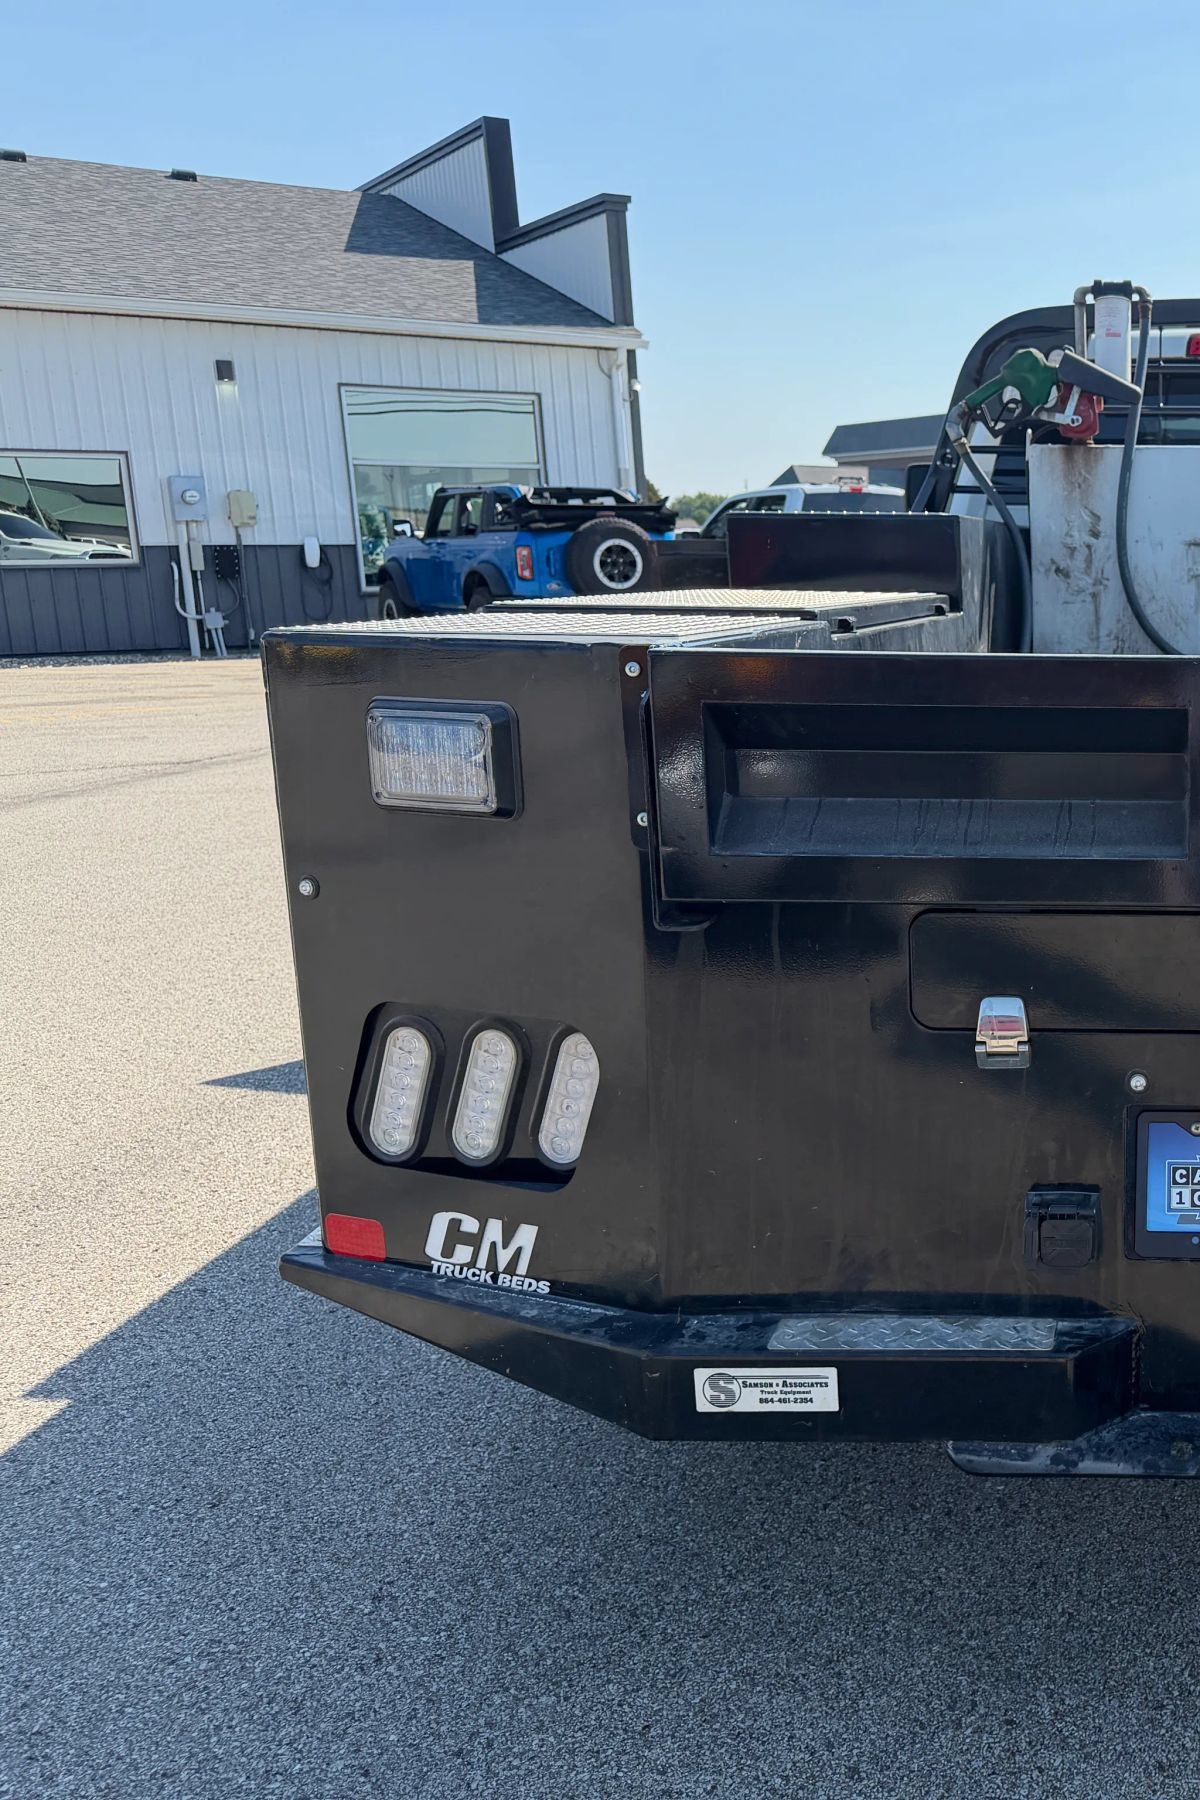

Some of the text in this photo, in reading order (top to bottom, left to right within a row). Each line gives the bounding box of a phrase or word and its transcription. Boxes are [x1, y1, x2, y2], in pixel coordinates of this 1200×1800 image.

[1174, 1190, 1187, 1206] 1
[425, 1211, 539, 1276] CM
[431, 1260, 551, 1295] TRUCK BEDS
